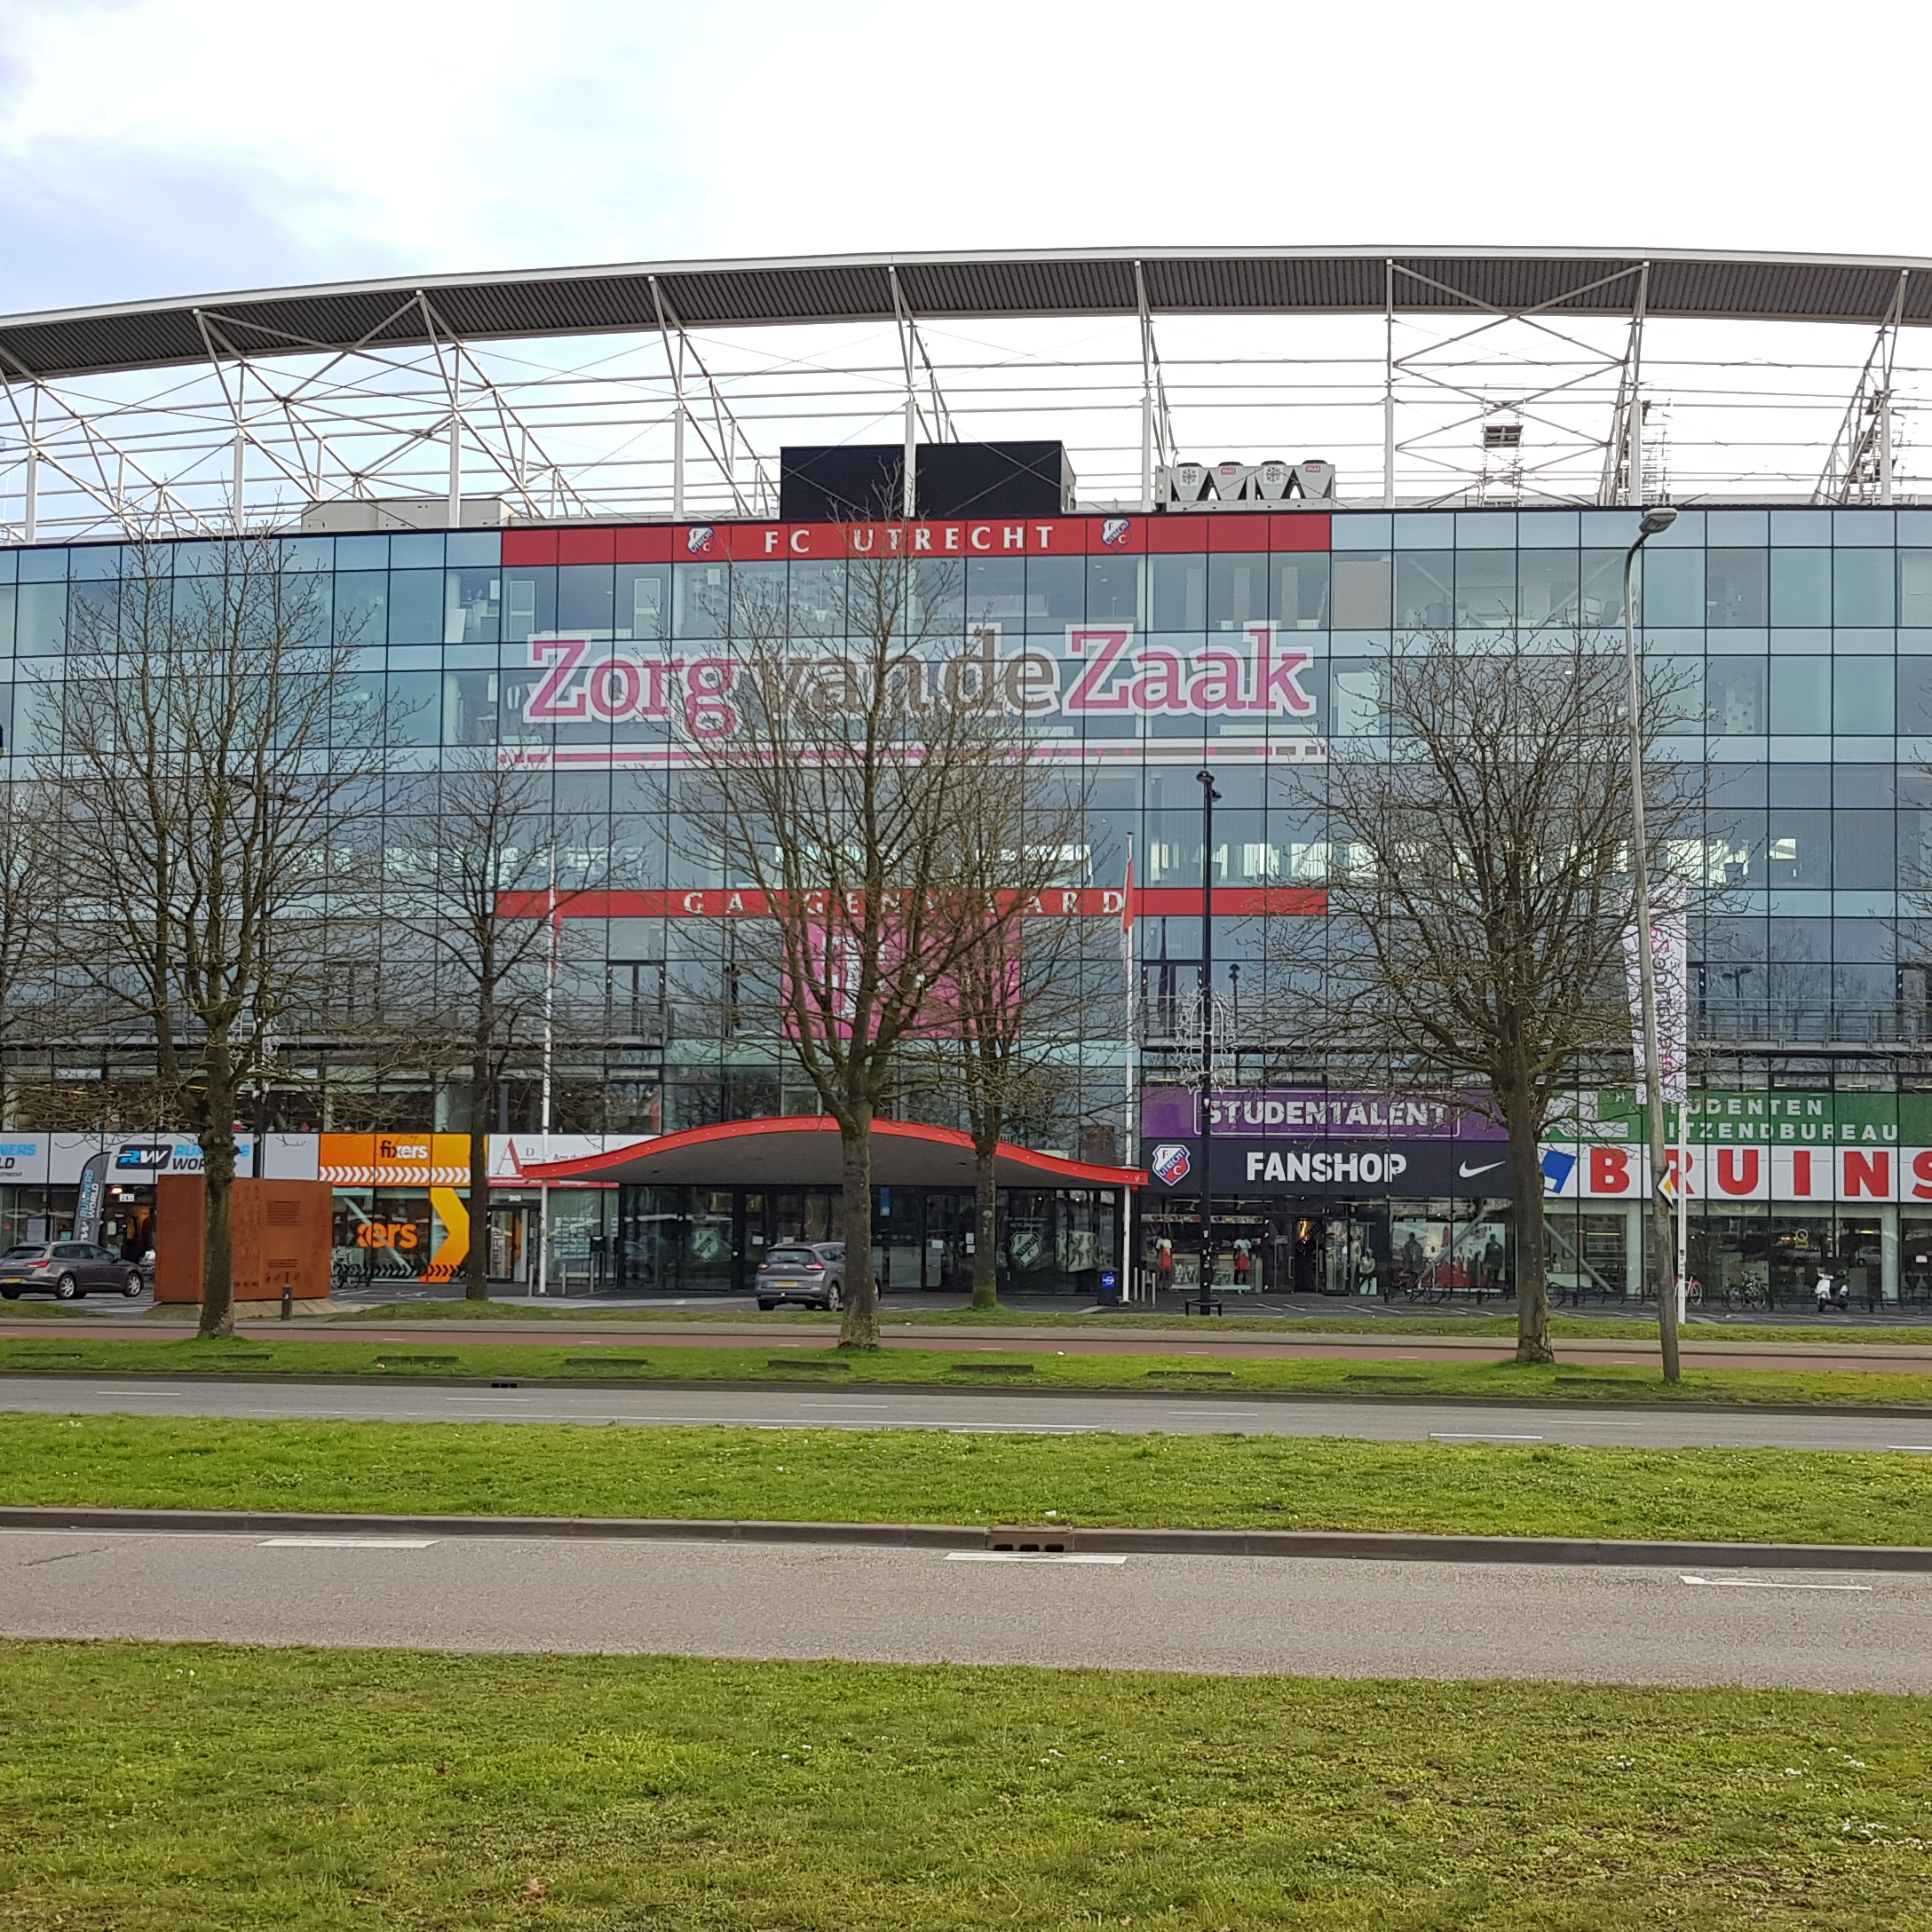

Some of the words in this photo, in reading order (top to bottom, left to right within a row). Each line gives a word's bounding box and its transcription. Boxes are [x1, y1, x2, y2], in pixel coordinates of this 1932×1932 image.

[702, 542, 711, 552] C
[764, 529, 810, 553] FC
[853, 526, 1053, 551] UTRECHT
[1118, 534, 1127, 544] C
[528, 638, 740, 740] Zorg
[1067, 629, 1311, 711] Zaak
[1208, 1100, 1449, 1128] STUDENTALENT
[1668, 1120, 1898, 1141] ITZENDBUREAU
[118, 1150, 169, 1164] RW
[380, 1140, 429, 1160] fixers
[526, 1147, 534, 1157] D
[1162, 1149, 1169, 1160] F
[1173, 1165, 1182, 1176] C
[1246, 1152, 1407, 1183] FANSHOP
[86, 1182, 99, 1219] WORLD
